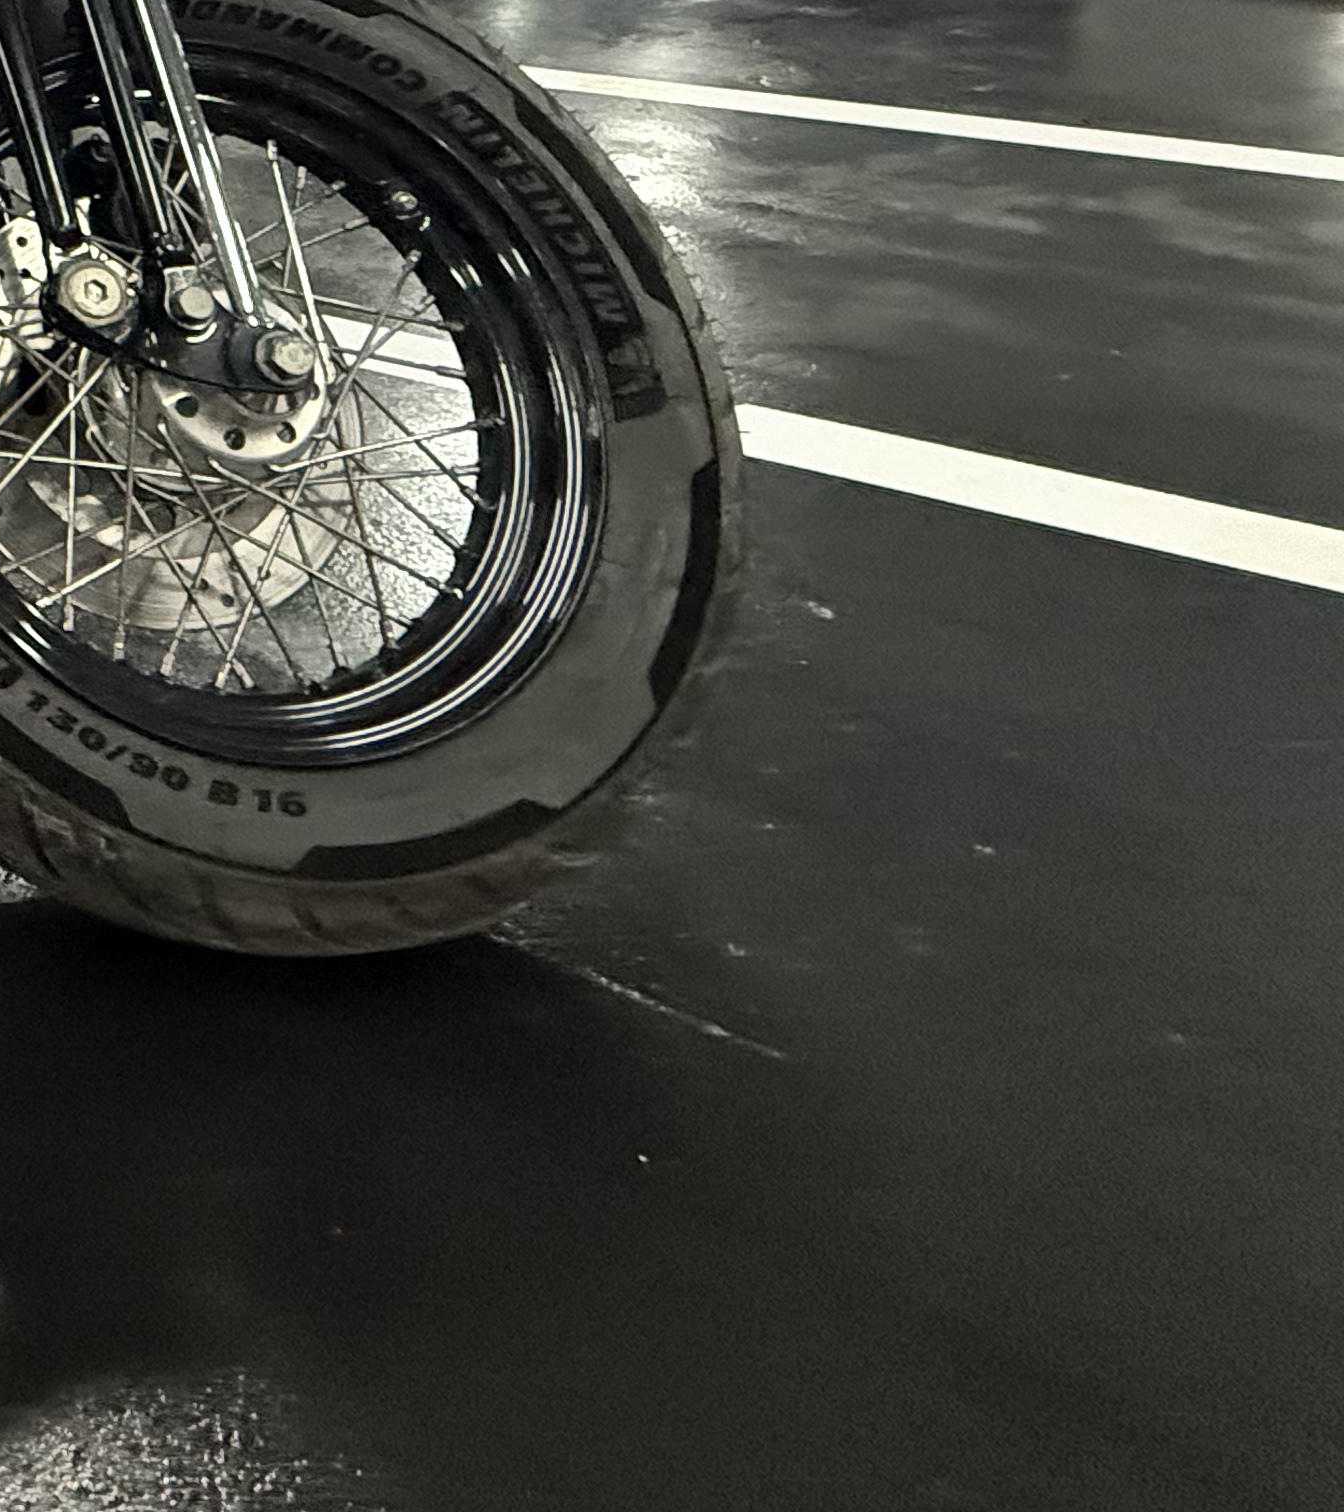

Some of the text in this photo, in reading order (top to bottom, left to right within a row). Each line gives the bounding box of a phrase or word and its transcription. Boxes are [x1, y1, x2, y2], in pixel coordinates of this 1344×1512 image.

[440, 96, 628, 326] MICHELIN
[25, 689, 190, 791] 130/90
[208, 779, 240, 806] B
[252, 788, 307, 817] 16
